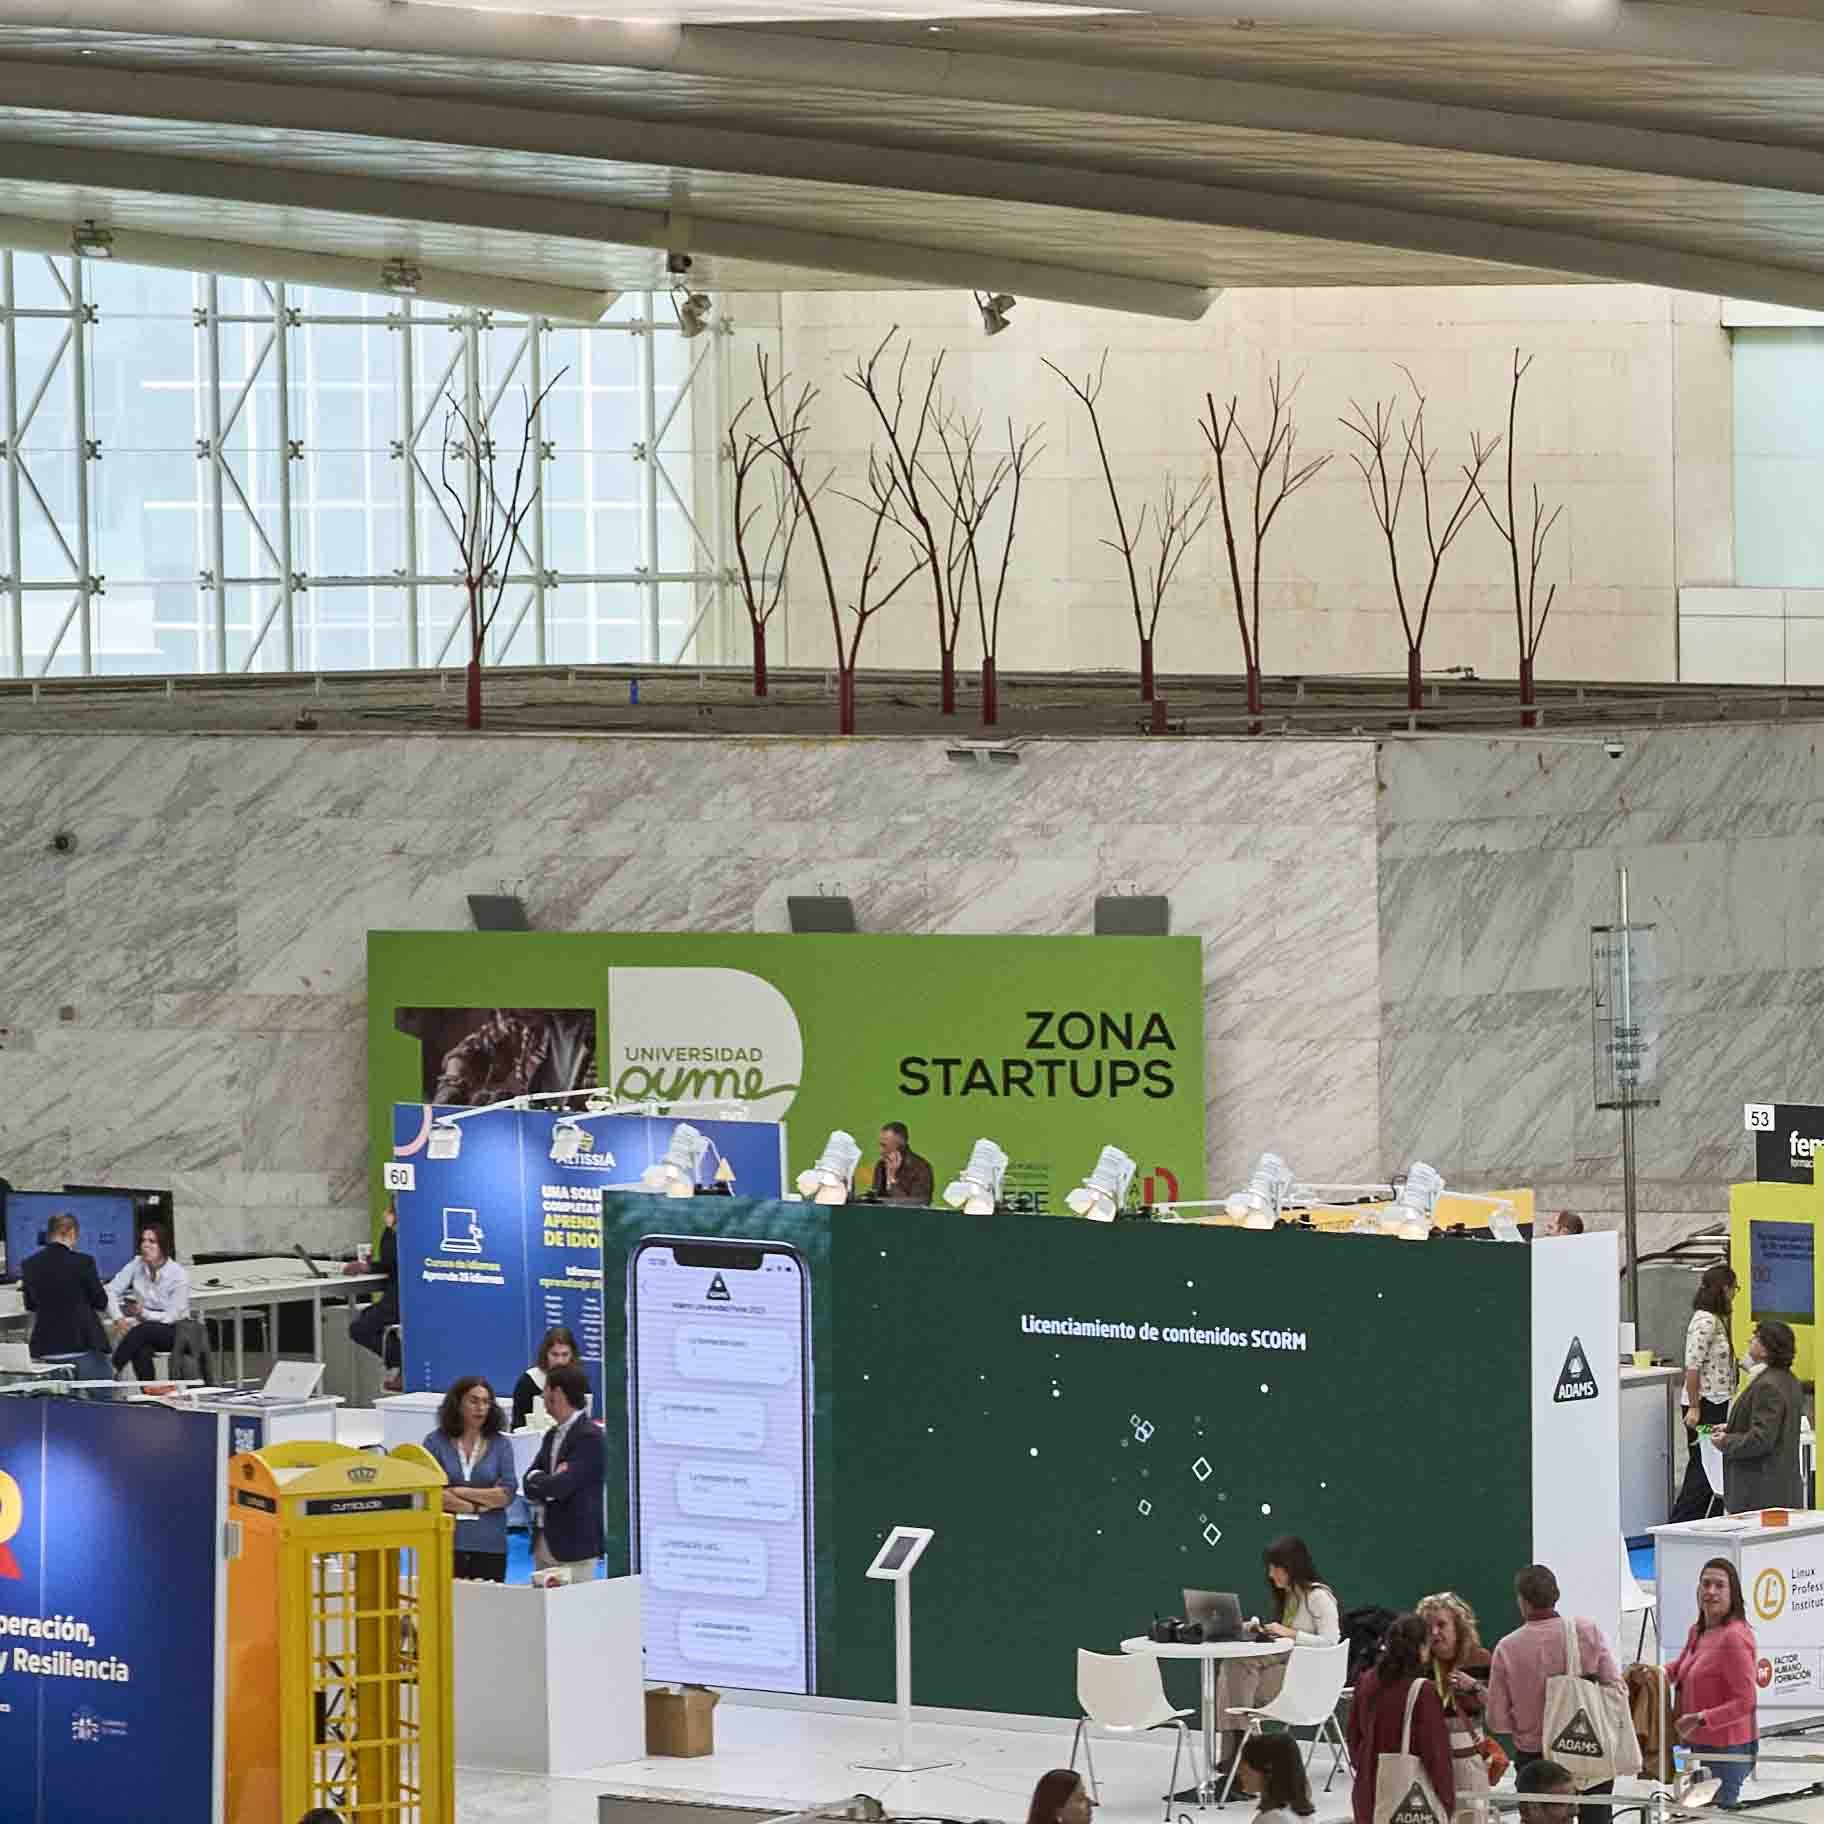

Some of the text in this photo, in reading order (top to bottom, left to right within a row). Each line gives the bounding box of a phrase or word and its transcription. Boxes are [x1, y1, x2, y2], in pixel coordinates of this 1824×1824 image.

[1024, 1011, 1176, 1052] ZONA
[624, 1046, 764, 1064] UNIVERSIDAD
[897, 1056, 1176, 1099] STARTUPS
[1751, 1110, 1770, 1128] 53
[390, 1170, 409, 1185] 60
[1021, 1314, 1308, 1352] Licenciamiento de contenidos SCORM
[1556, 1380, 1596, 1402] ADAMS
[1791, 1567, 1816, 1580] Linux
[13, 1647, 130, 1683] Resiliencia
[1557, 1737, 1599, 1755] ADAMS
